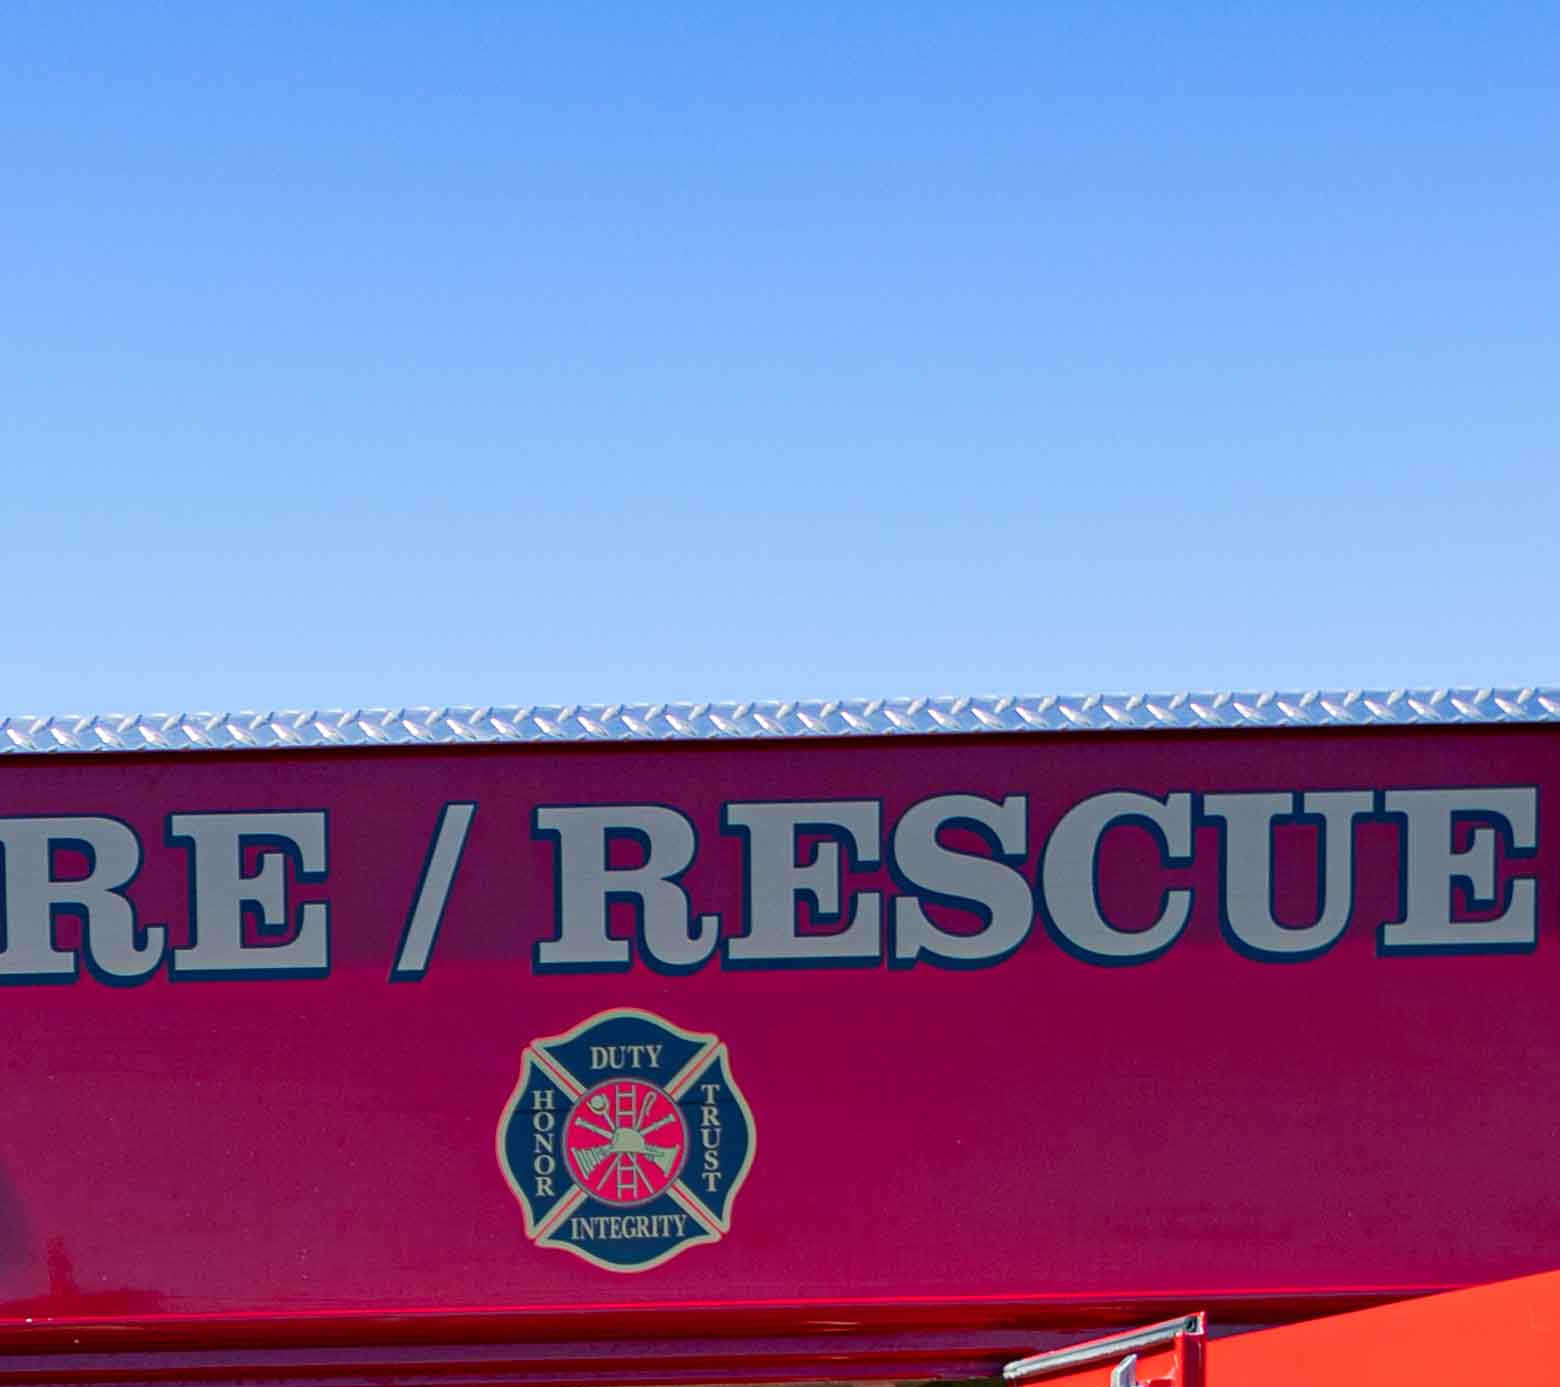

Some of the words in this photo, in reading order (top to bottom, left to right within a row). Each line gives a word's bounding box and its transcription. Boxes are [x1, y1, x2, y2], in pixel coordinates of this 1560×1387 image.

[388, 802, 477, 983] /
[531, 786, 1539, 977] RESCUE
[591, 1044, 663, 1069] DUTY
[533, 1089, 555, 1197] HONOR
[701, 1084, 721, 1192] TRUST
[570, 1214, 688, 1240] INTEGRITY
